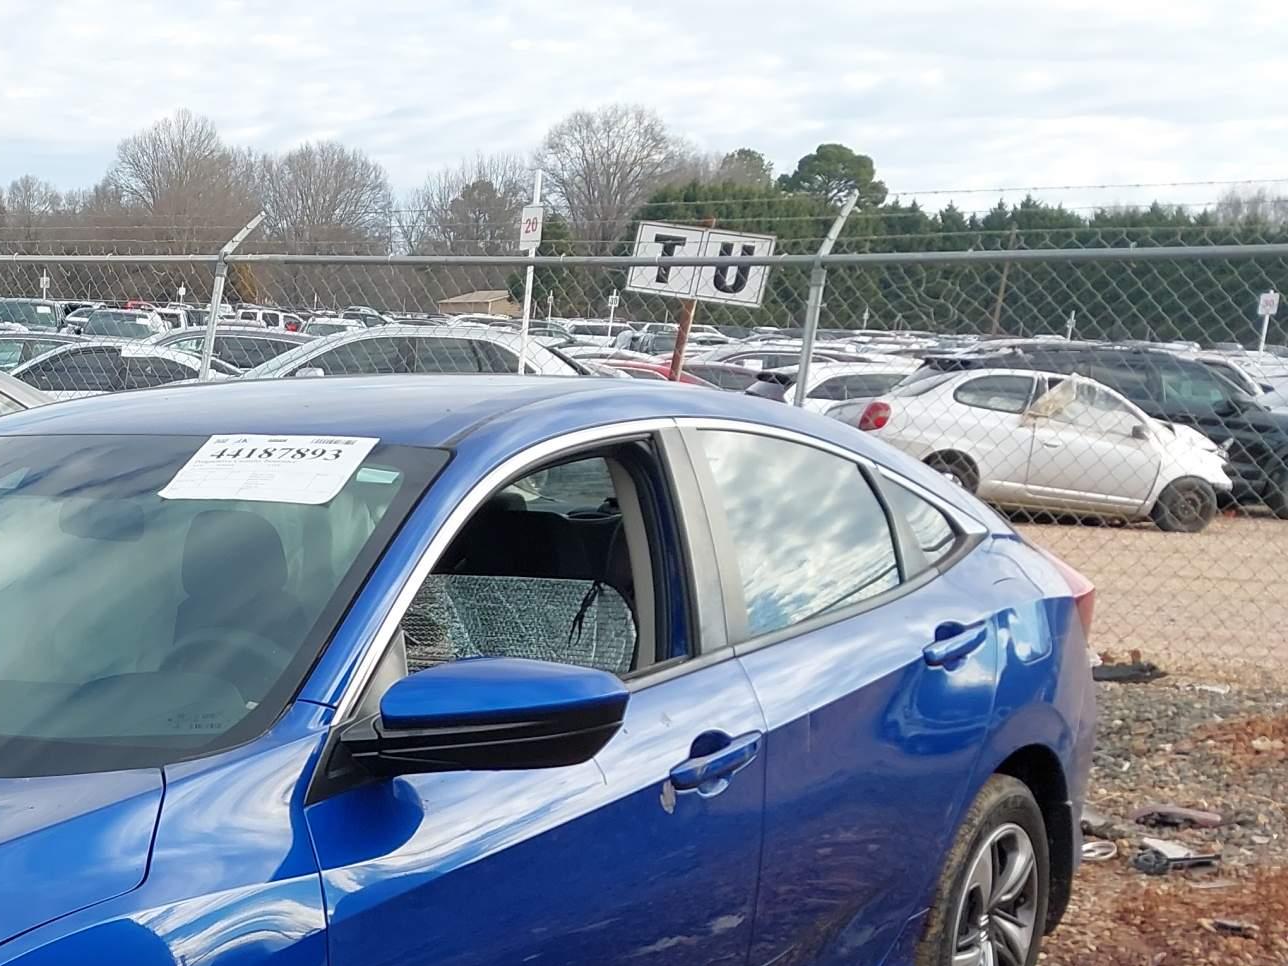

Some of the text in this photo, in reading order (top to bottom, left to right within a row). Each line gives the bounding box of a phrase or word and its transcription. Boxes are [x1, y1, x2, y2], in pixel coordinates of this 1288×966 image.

[524, 217, 539, 234] 20
[654, 233, 756, 294] T U
[210, 447, 343, 461] 44187893
